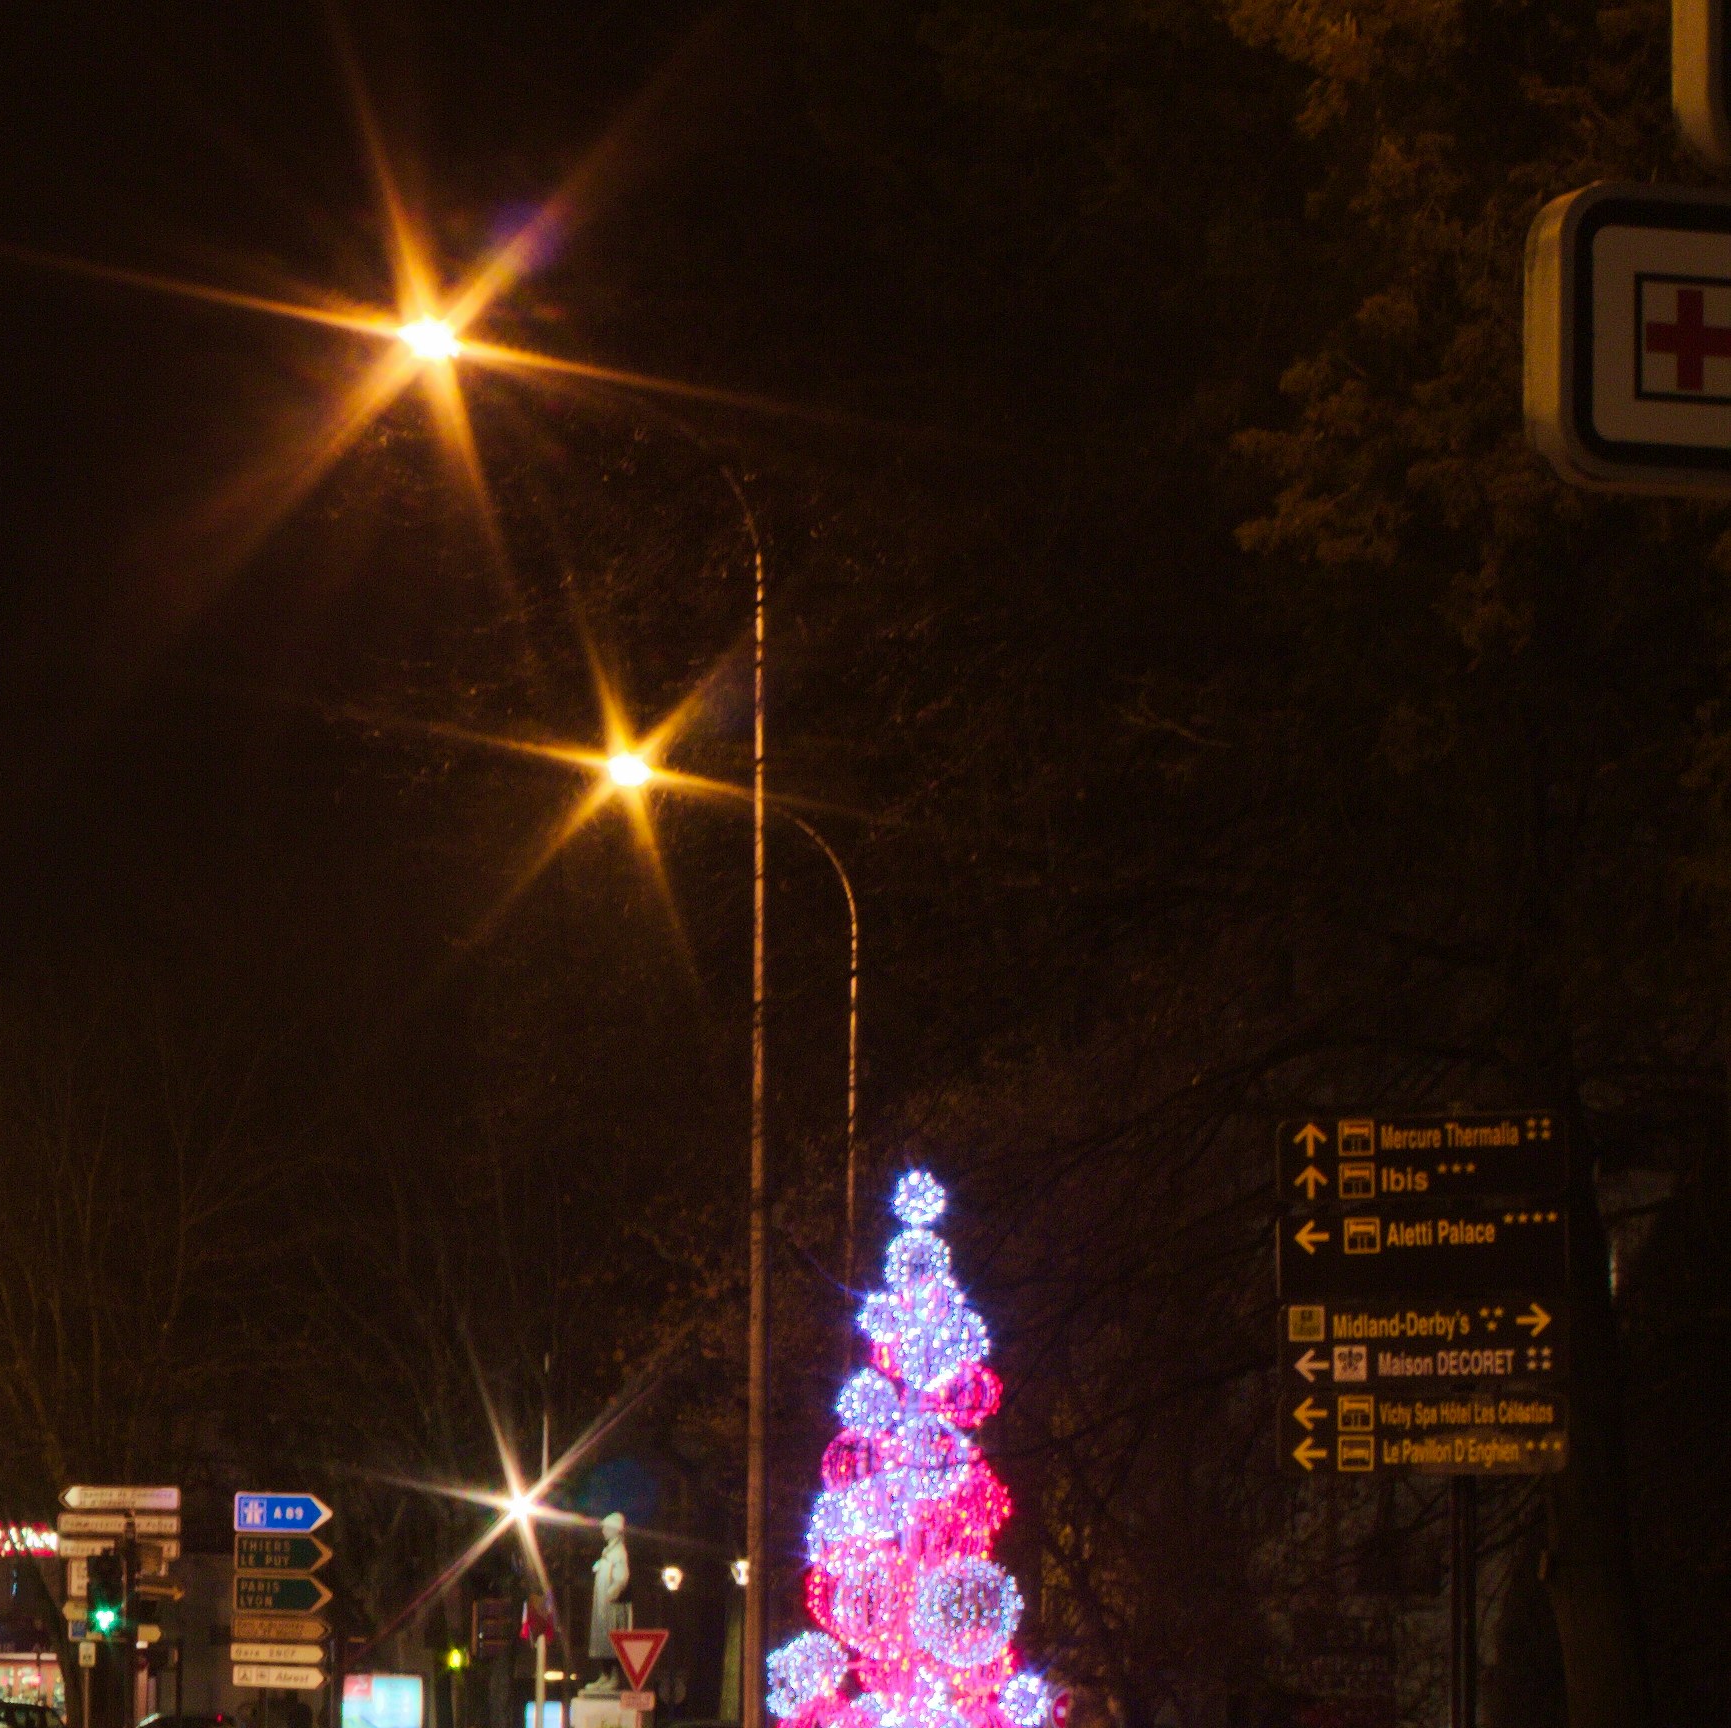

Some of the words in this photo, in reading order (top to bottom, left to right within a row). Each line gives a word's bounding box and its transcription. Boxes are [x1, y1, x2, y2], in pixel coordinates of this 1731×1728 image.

[1381, 1125, 1441, 1149] Mercure
[1445, 1120, 1519, 1147] Thermalia
[1381, 1166, 1429, 1192] Ibis
[1387, 1219, 1432, 1247] Aletti
[1438, 1218, 1496, 1245] Palace
[1333, 1310, 1470, 1341] Midland-Derby's
[1378, 1351, 1433, 1376] Maison
[1438, 1349, 1515, 1376] DECORET
[1379, 1401, 1412, 1429] Vichy
[1414, 1401, 1437, 1429] Spa
[1474, 1402, 1495, 1424] Les
[1383, 1440, 1399, 1464] Le
[1402, 1438, 1452, 1464] Pavillon
[274, 1506, 283, 1520] A
[242, 1540, 291, 1552] THIERS
